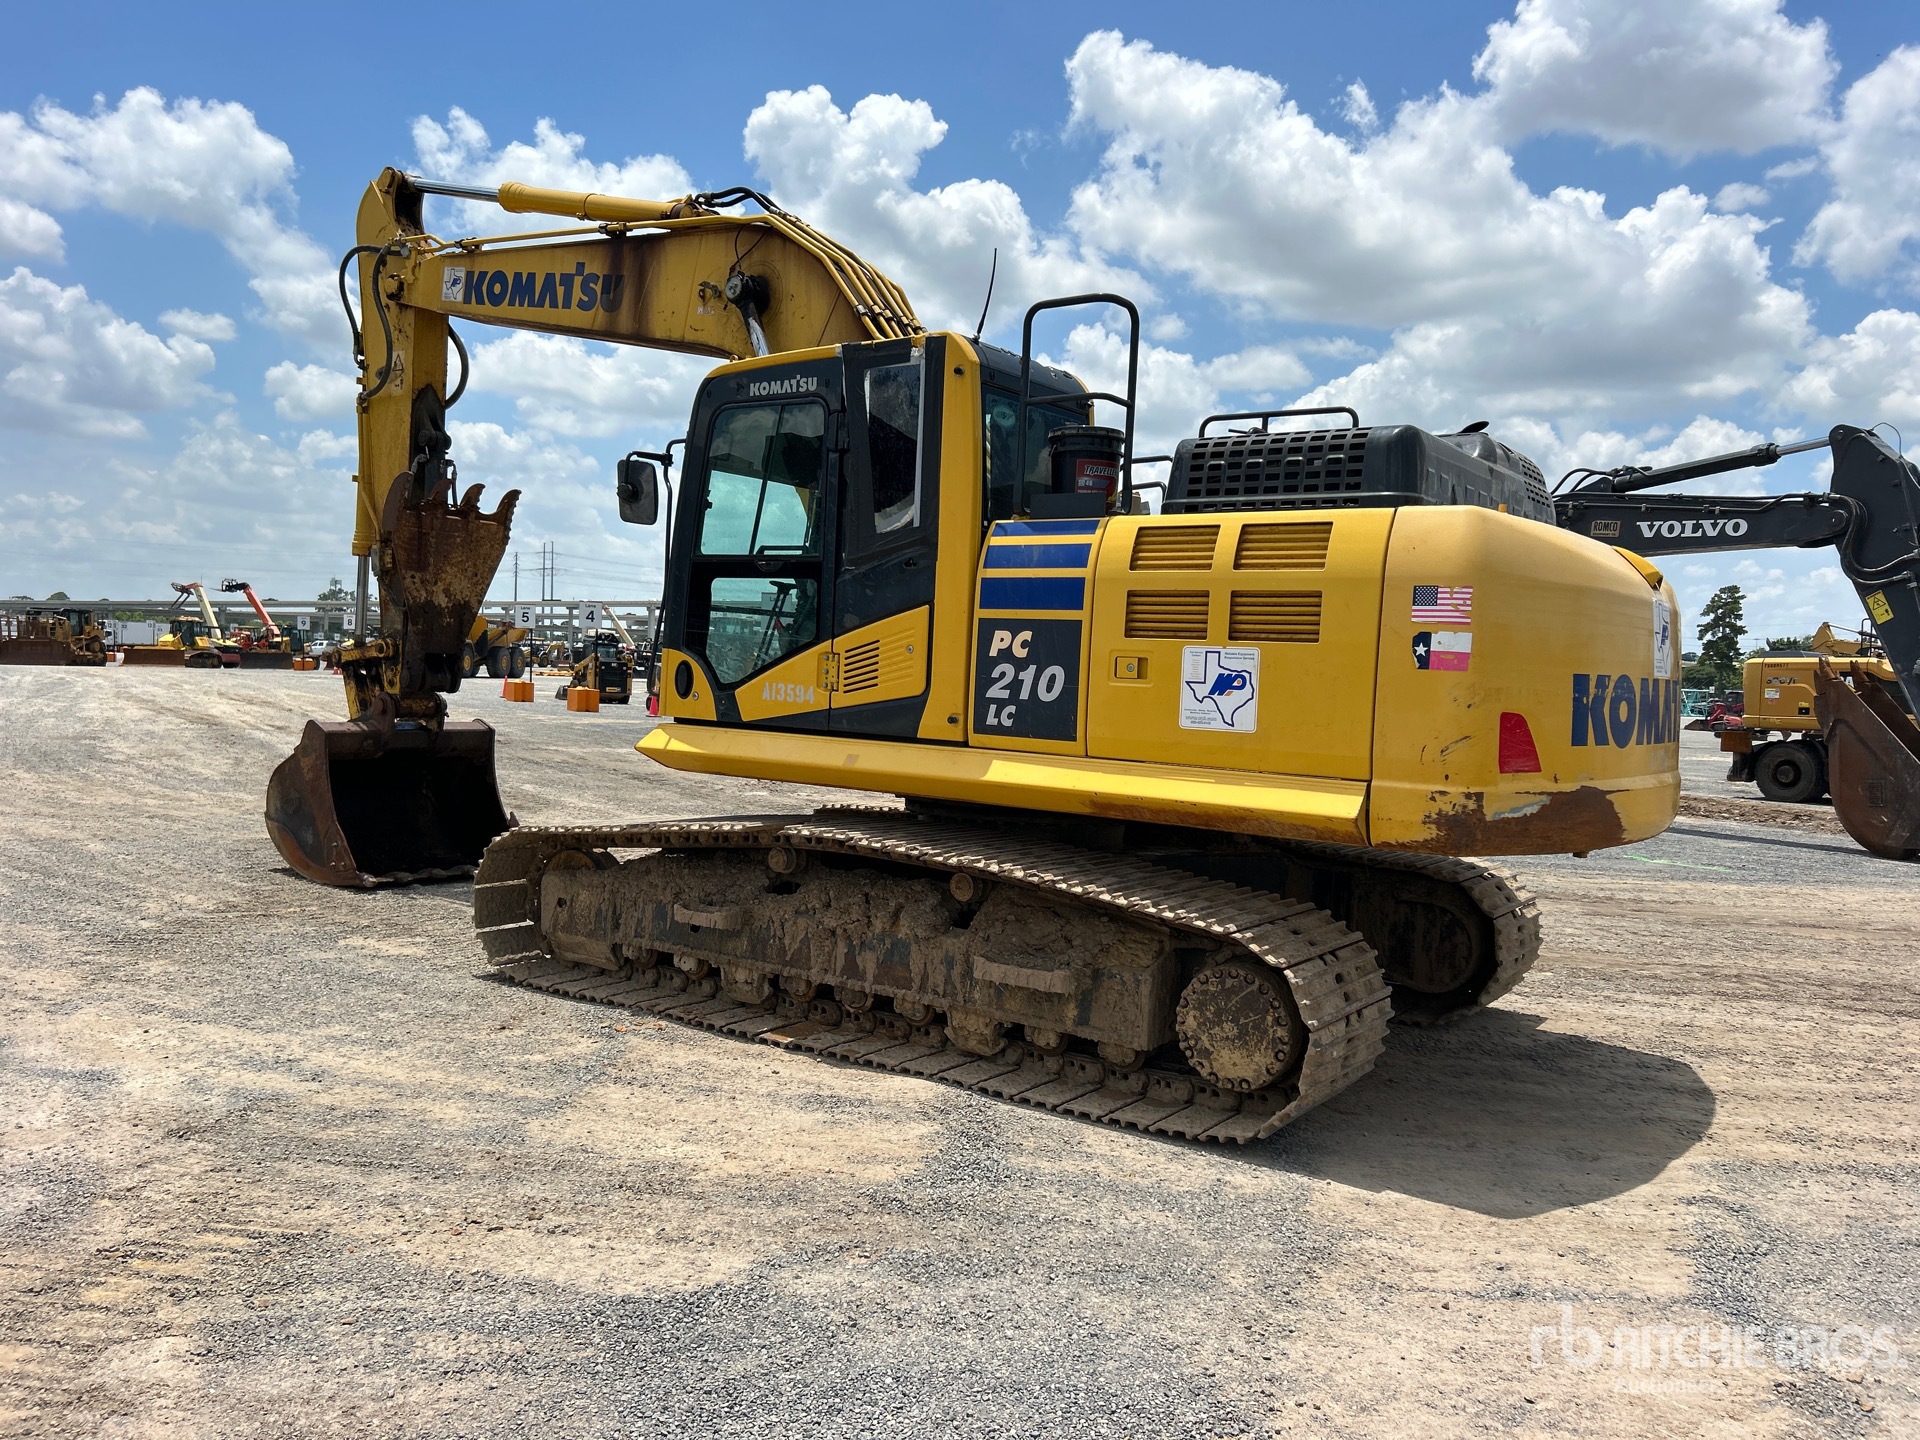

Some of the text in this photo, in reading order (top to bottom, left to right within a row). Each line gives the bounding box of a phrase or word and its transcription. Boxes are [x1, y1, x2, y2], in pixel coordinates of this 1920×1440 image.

[463, 262, 625, 313] KOMATSU
[749, 374, 818, 397] KOMATSU
[1593, 521, 1618, 532] ROMCO
[1636, 518, 1748, 538] VOLVO
[521, 612, 530, 622] 5
[585, 610, 595, 622] 4
[988, 630, 1033, 658] PC
[762, 682, 815, 704] A13594
[985, 663, 1065, 702] 210
[985, 704, 1017, 727] LC
